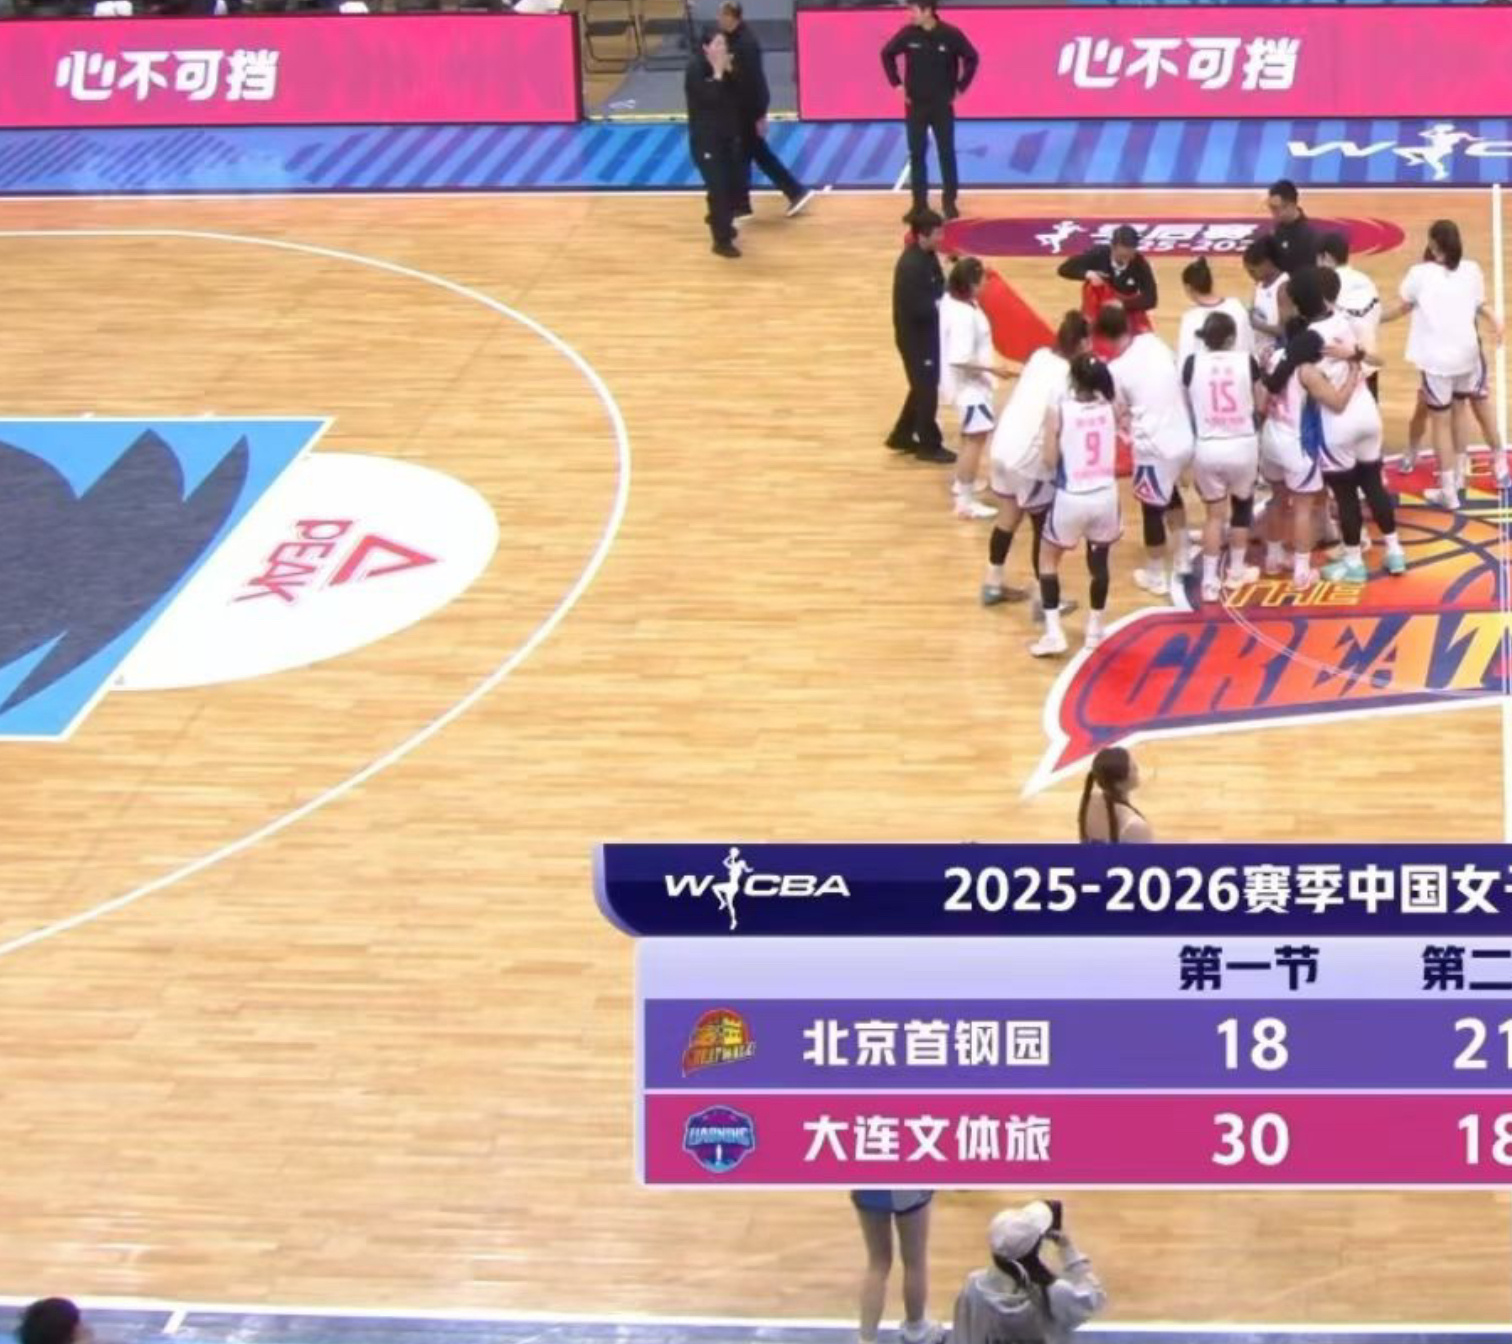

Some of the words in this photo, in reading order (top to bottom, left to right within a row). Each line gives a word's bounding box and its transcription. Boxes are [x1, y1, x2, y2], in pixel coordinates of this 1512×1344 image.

[56, 50, 281, 102] 心不可挡
[1057, 37, 1302, 90] 心不可挡
[1209, 379, 1237, 414] 15
[1084, 431, 1101, 465] 9
[231, 519, 354, 604] PEAK
